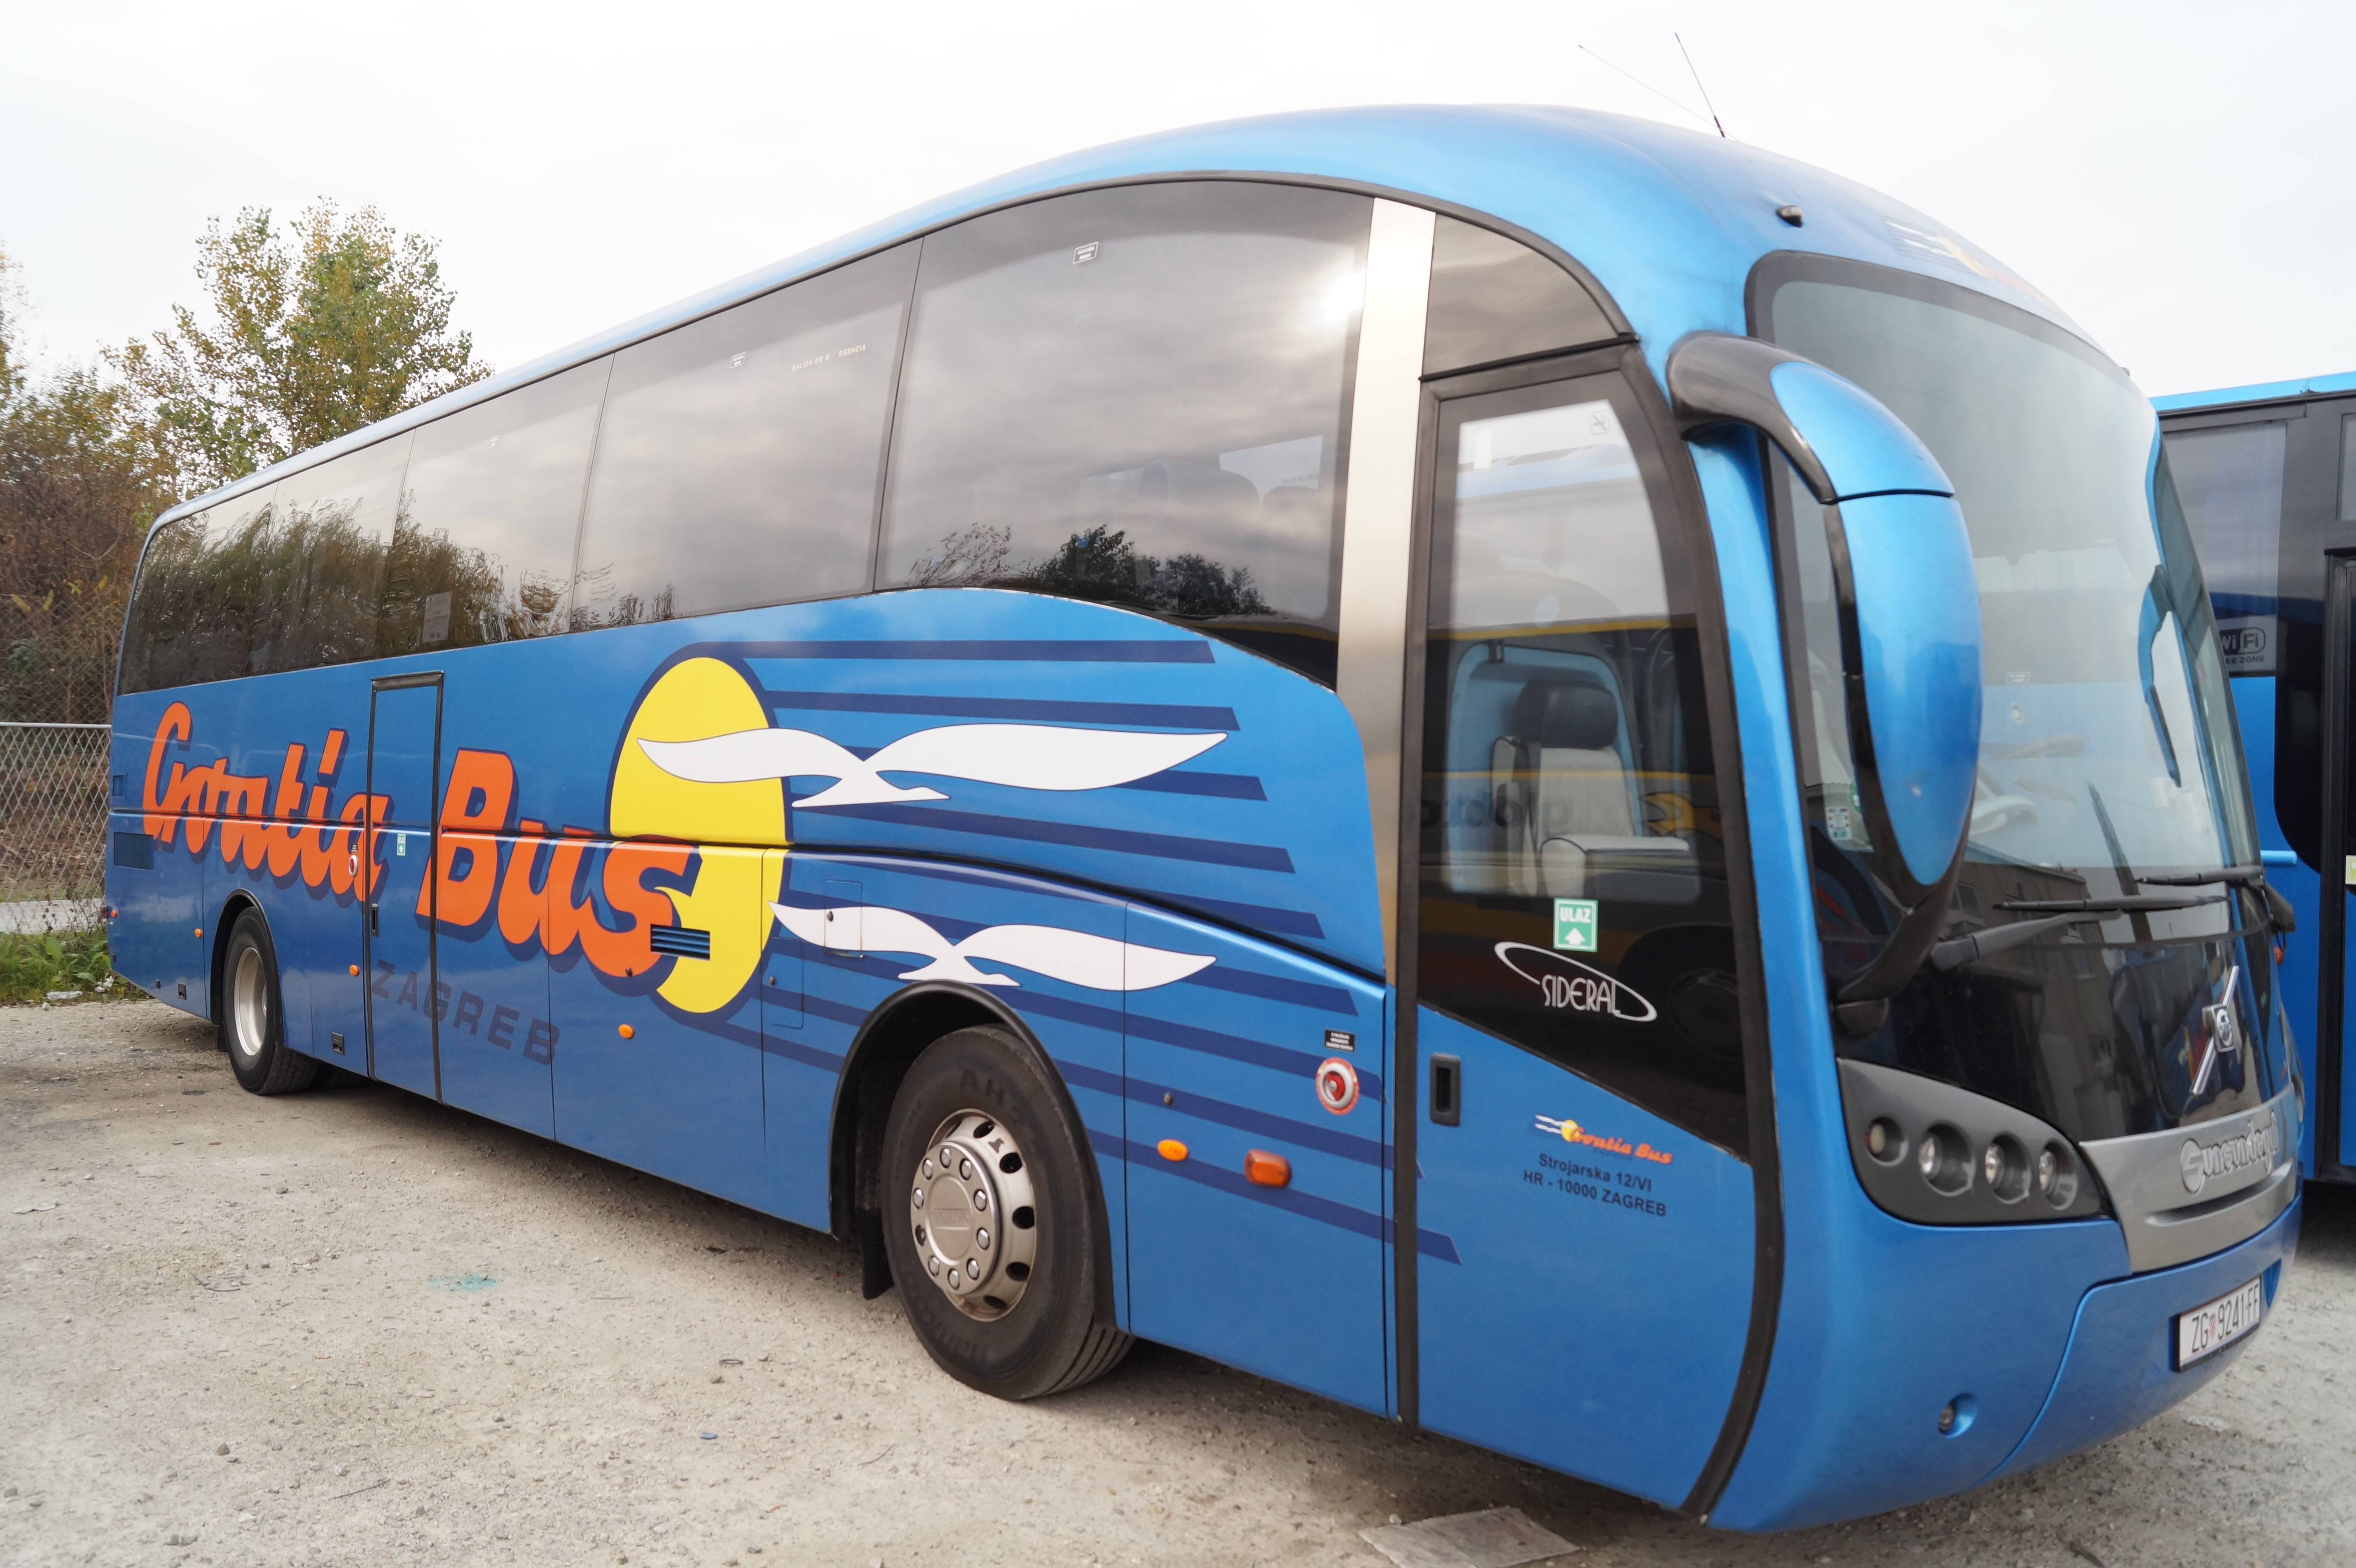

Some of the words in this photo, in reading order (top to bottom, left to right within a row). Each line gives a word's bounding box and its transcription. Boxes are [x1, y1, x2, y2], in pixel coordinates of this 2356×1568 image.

[792, 359, 812, 371] SALIDA
[815, 355, 823, 364] DE
[2240, 655, 2264, 664] ZONE
[143, 701, 390, 902] Croatia
[415, 750, 699, 977] Bus
[1560, 907, 1591, 924] ULAZ
[372, 959, 560, 1065] ZAGREB
[1542, 974, 1621, 1014] SIDERAL
[1570, 1126, 1632, 1155] Croatia
[1634, 1142, 1672, 1164] Bus
[1539, 1153, 1611, 1182] Strojarska
[1617, 1171, 1652, 1192] 12/VI
[1523, 1169, 1543, 1186] HR
[1558, 1178, 1597, 1200] 10000
[1602, 1188, 1666, 1217] ZAGREB
[2191, 1311, 2209, 1353] ZG
[2218, 1283, 2259, 1340] 9241-FF
